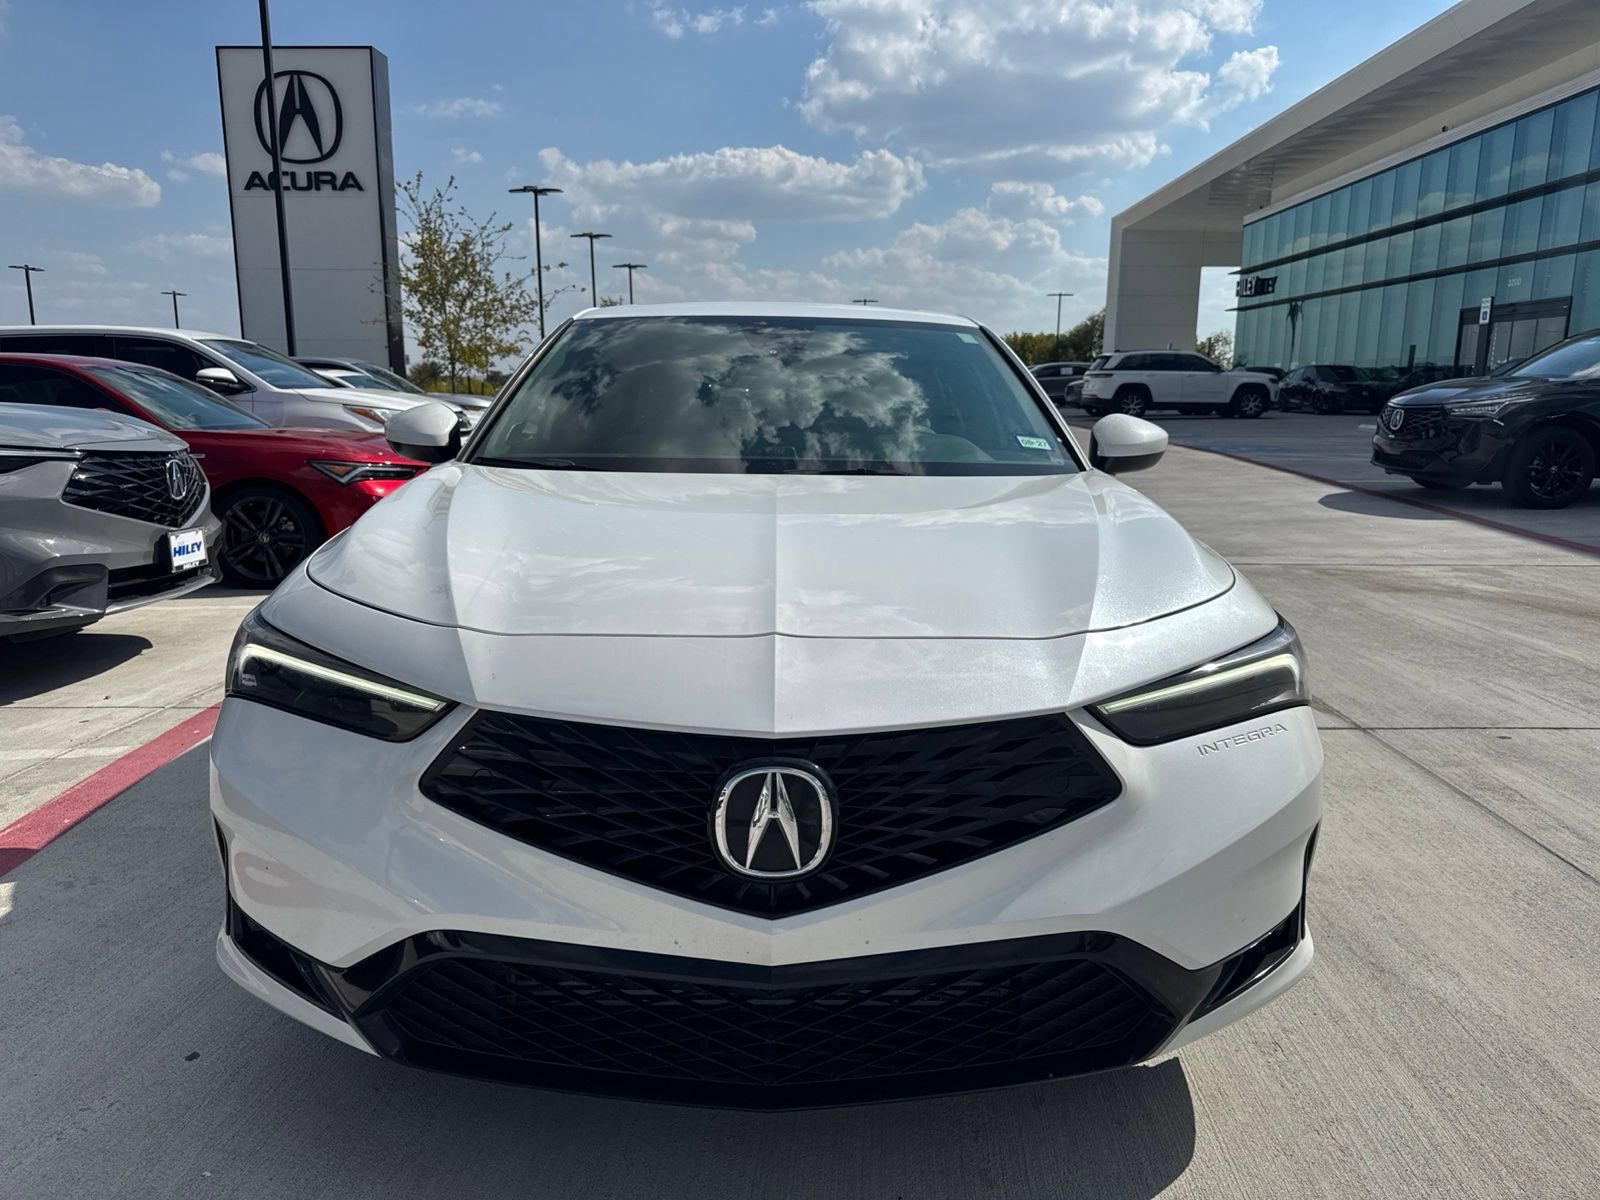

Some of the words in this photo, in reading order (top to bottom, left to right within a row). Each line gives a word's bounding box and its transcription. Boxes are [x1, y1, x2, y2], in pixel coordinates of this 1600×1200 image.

[244, 171, 363, 191] ACURA
[173, 541, 202, 557] HILEY
[1197, 723, 1288, 756] INTEGRA
